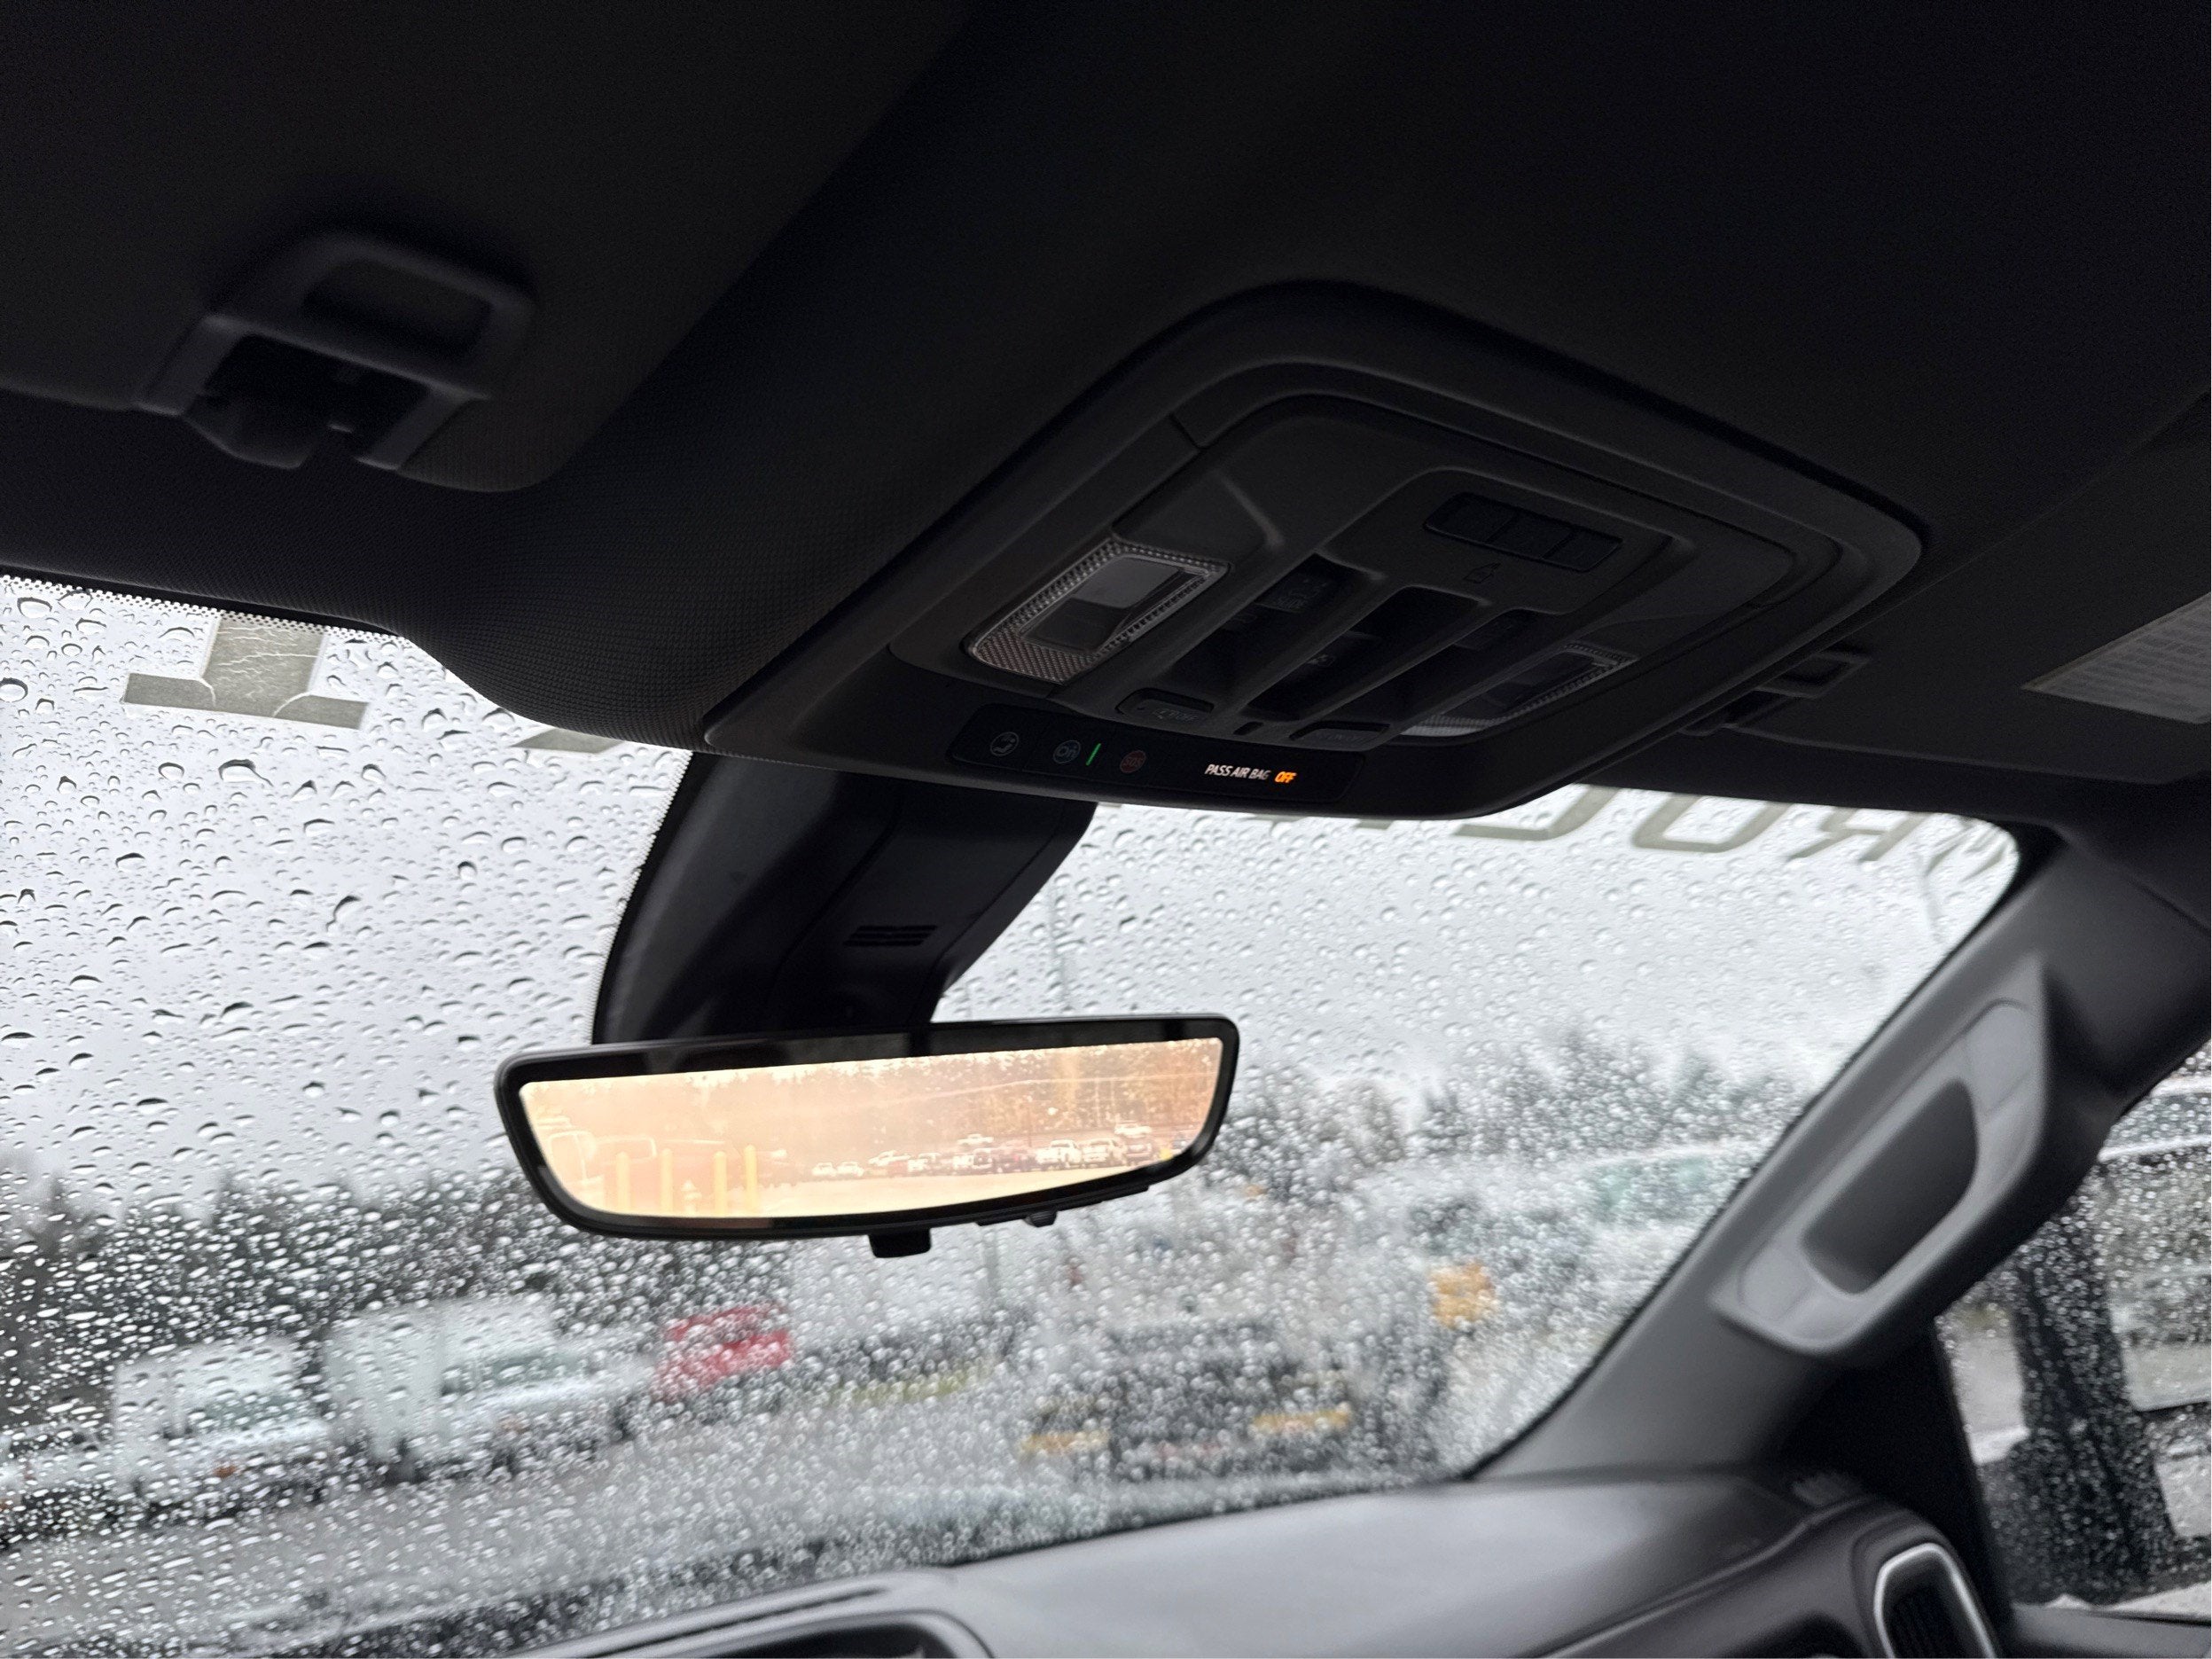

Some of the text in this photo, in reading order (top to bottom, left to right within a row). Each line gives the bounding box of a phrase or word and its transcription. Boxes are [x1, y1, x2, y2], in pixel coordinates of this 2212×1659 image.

[1122, 755, 1144, 769] SOS
[1204, 763, 1298, 784] PASS AIR BAG OFF
